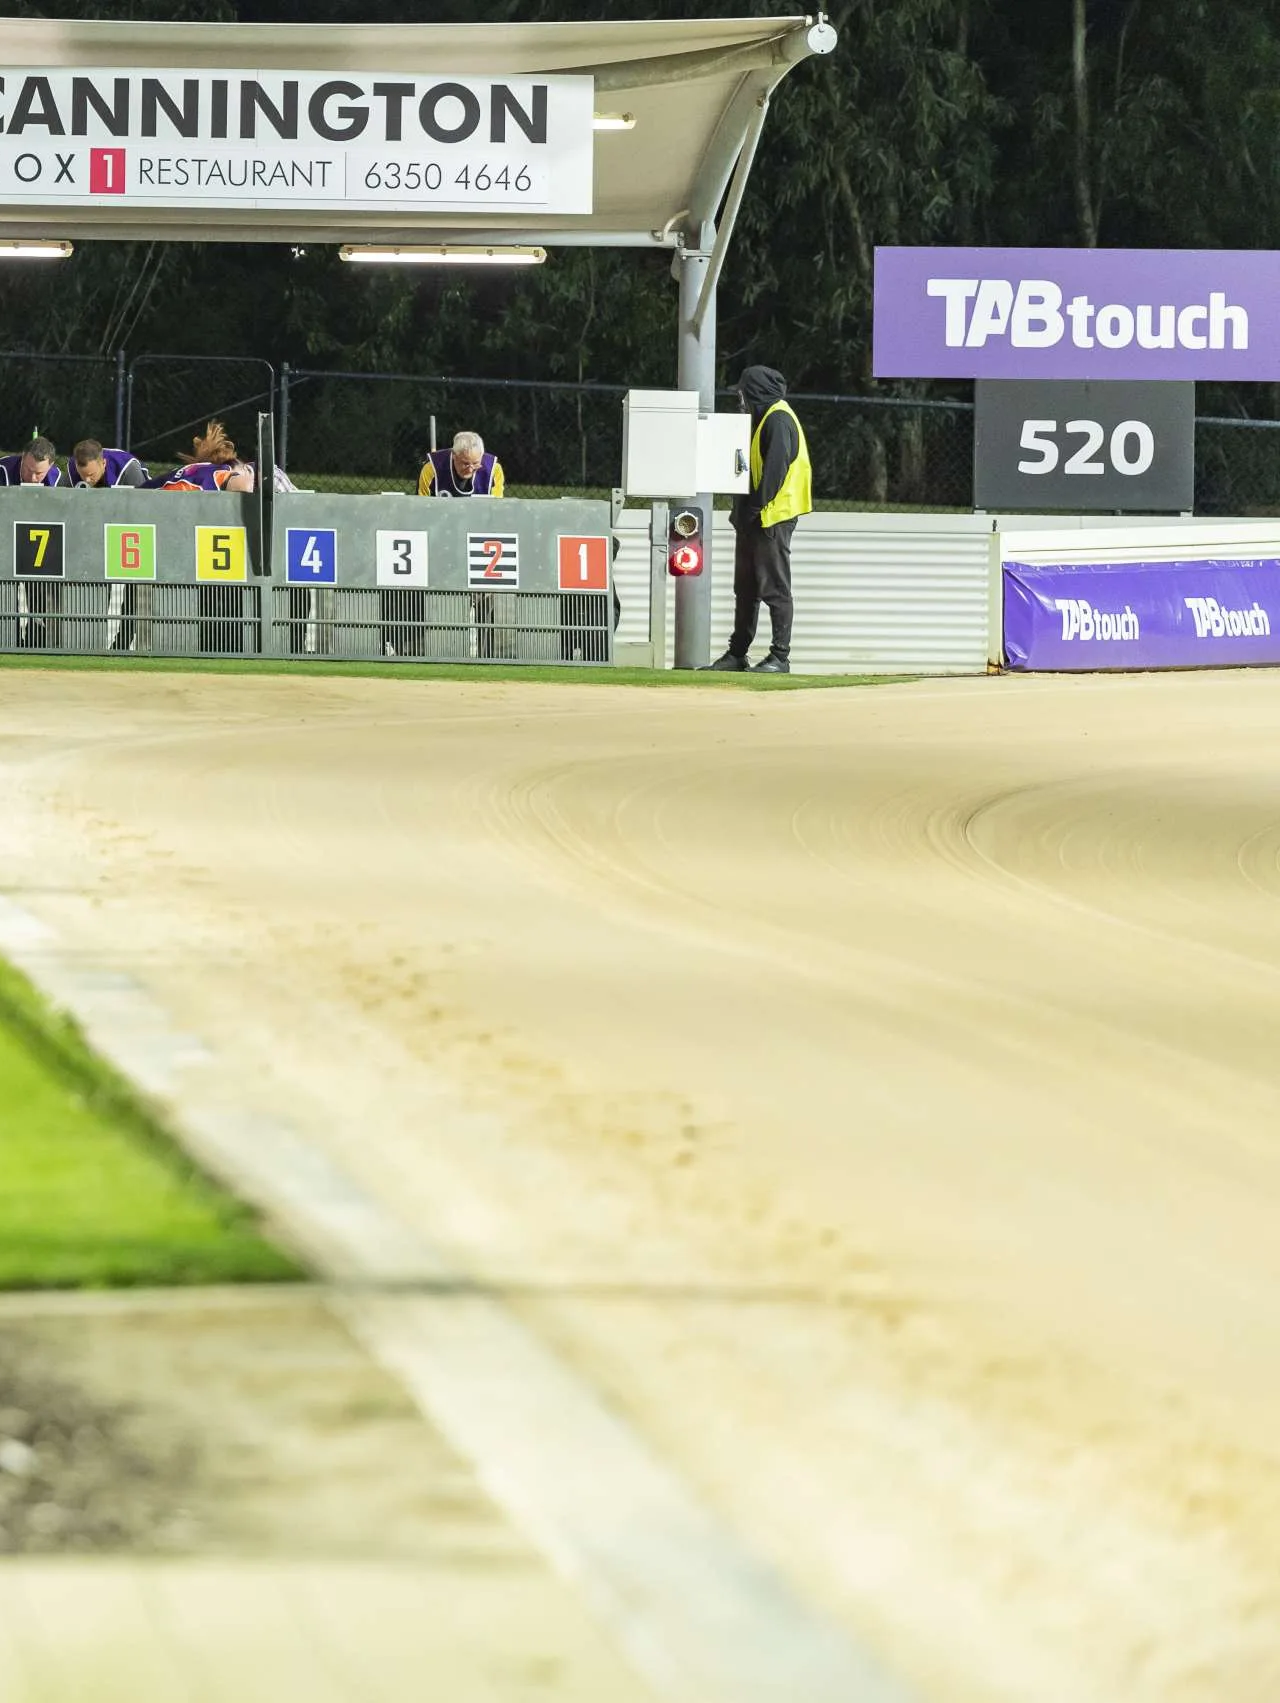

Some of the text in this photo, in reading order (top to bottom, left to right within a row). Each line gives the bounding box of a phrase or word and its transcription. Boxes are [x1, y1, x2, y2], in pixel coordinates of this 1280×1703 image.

[101, 154, 114, 188] 1
[139, 158, 333, 188] RESTAURANT
[364, 162, 442, 190] 6350
[454, 163, 532, 192] 4646
[927, 279, 1249, 350] TABtouch
[1018, 420, 1154, 475] 520
[29, 529, 50, 567] 7
[120, 532, 140, 569] 6
[212, 534, 231, 571] 5
[300, 536, 323, 574] 4
[393, 539, 412, 575] 3
[483, 541, 503, 578] 2
[577, 543, 588, 581] 1
[1055, 599, 1140, 641] TABtouch
[1184, 597, 1271, 638] TABtouch
